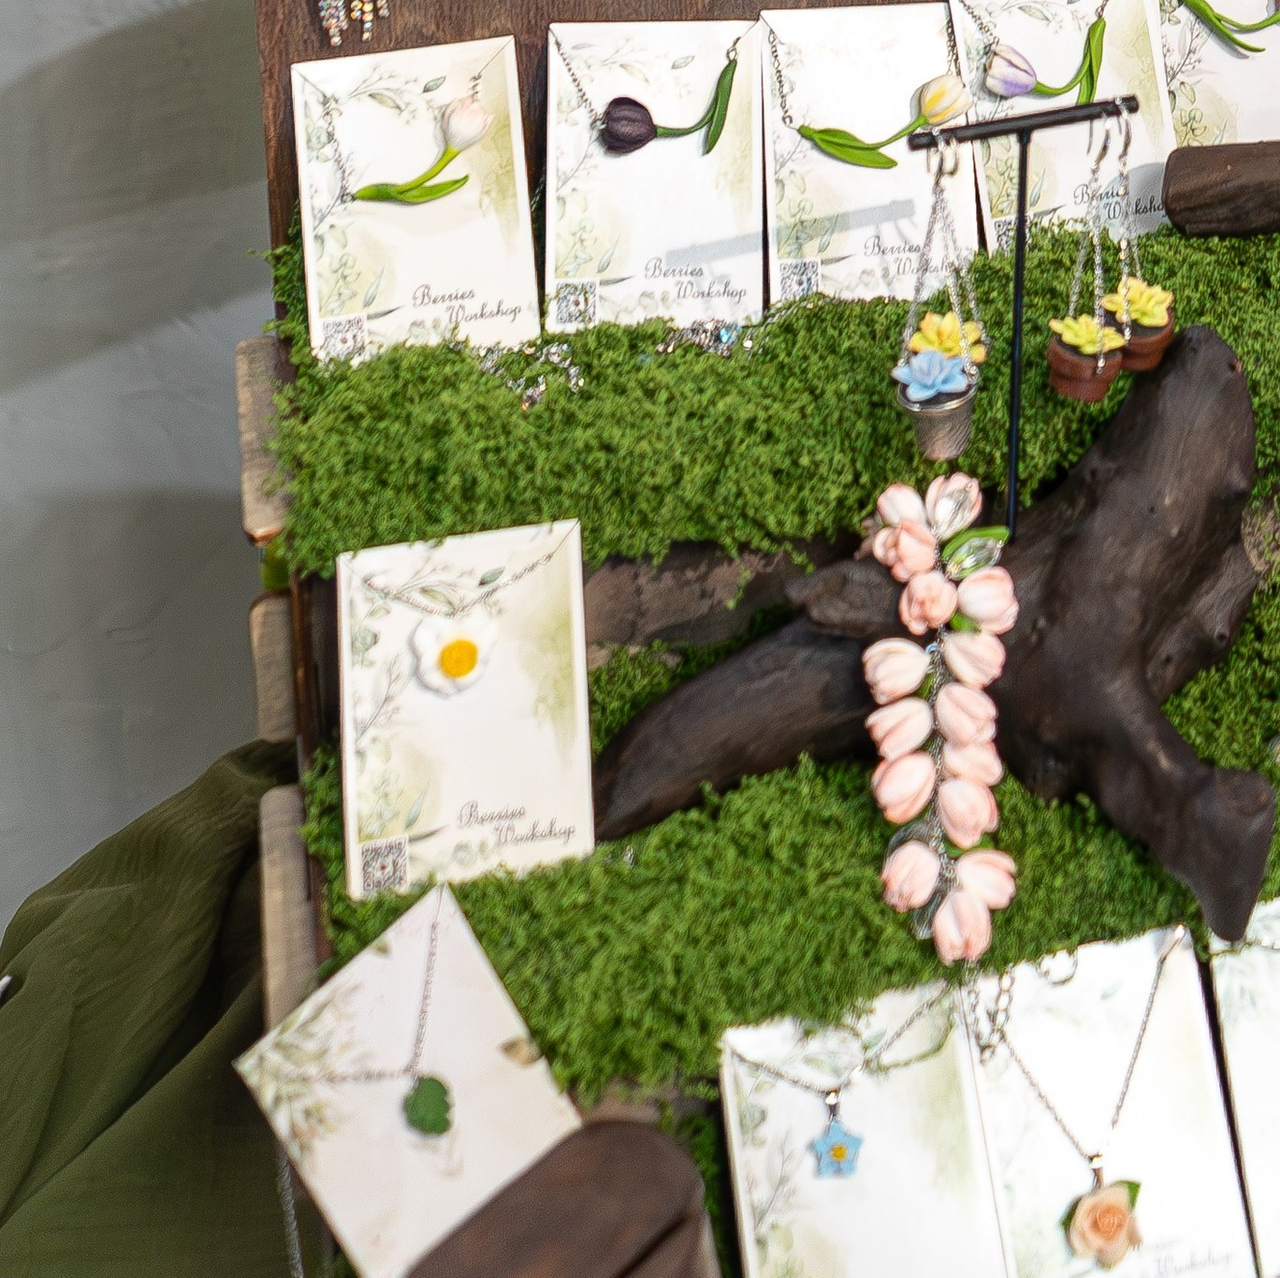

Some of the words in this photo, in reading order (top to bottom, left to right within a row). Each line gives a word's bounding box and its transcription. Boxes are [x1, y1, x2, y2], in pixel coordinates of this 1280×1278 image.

[864, 235, 920, 257] Berries
[644, 256, 704, 279] Berries
[412, 284, 475, 307] Berries
[675, 280, 747, 305] Workshop
[446, 299, 522, 324] Workshop
